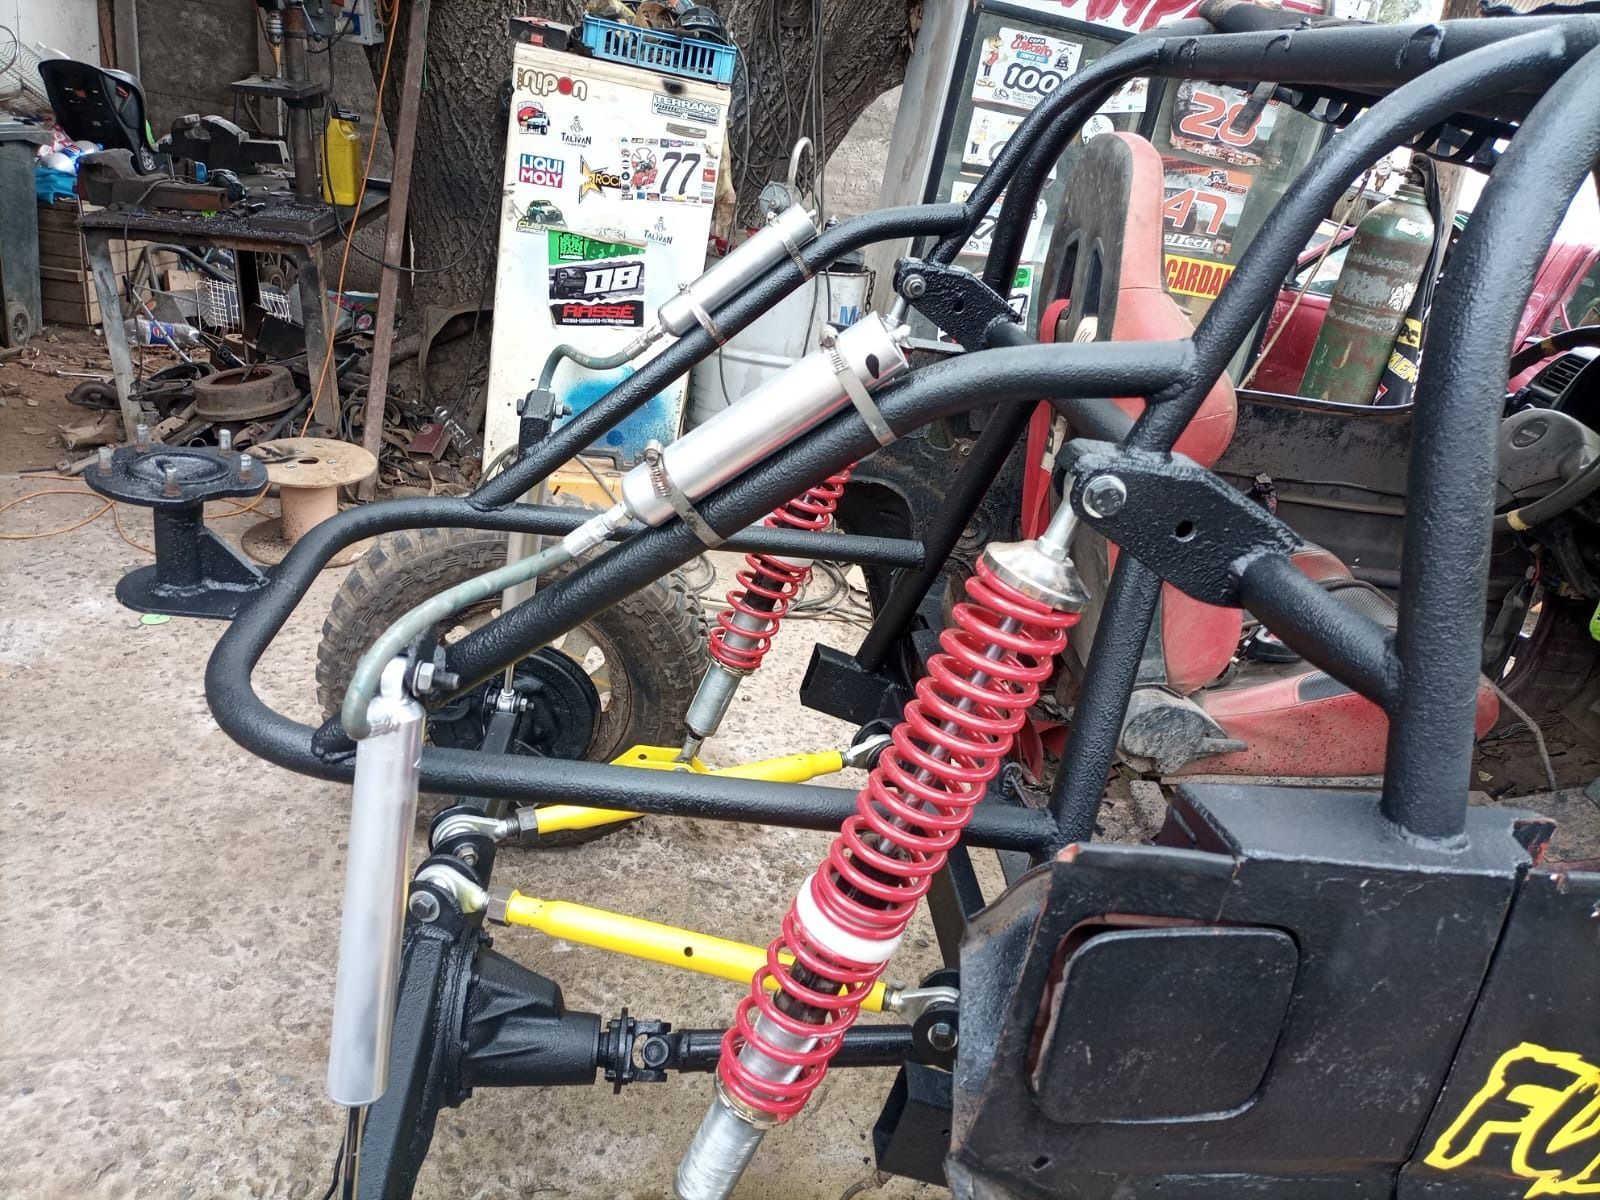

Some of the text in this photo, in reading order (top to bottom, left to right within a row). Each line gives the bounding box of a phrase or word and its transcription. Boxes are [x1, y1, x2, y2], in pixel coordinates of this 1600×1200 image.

[1004, 63, 1063, 96] 100
[654, 94, 720, 114] TERRANO
[521, 154, 563, 174] LIQUI
[660, 151, 701, 195] 77
[520, 168, 562, 187] MOLY
[594, 173, 621, 188] ROC
[1163, 188, 1228, 235] 47
[1164, 232, 1213, 250] elTech
